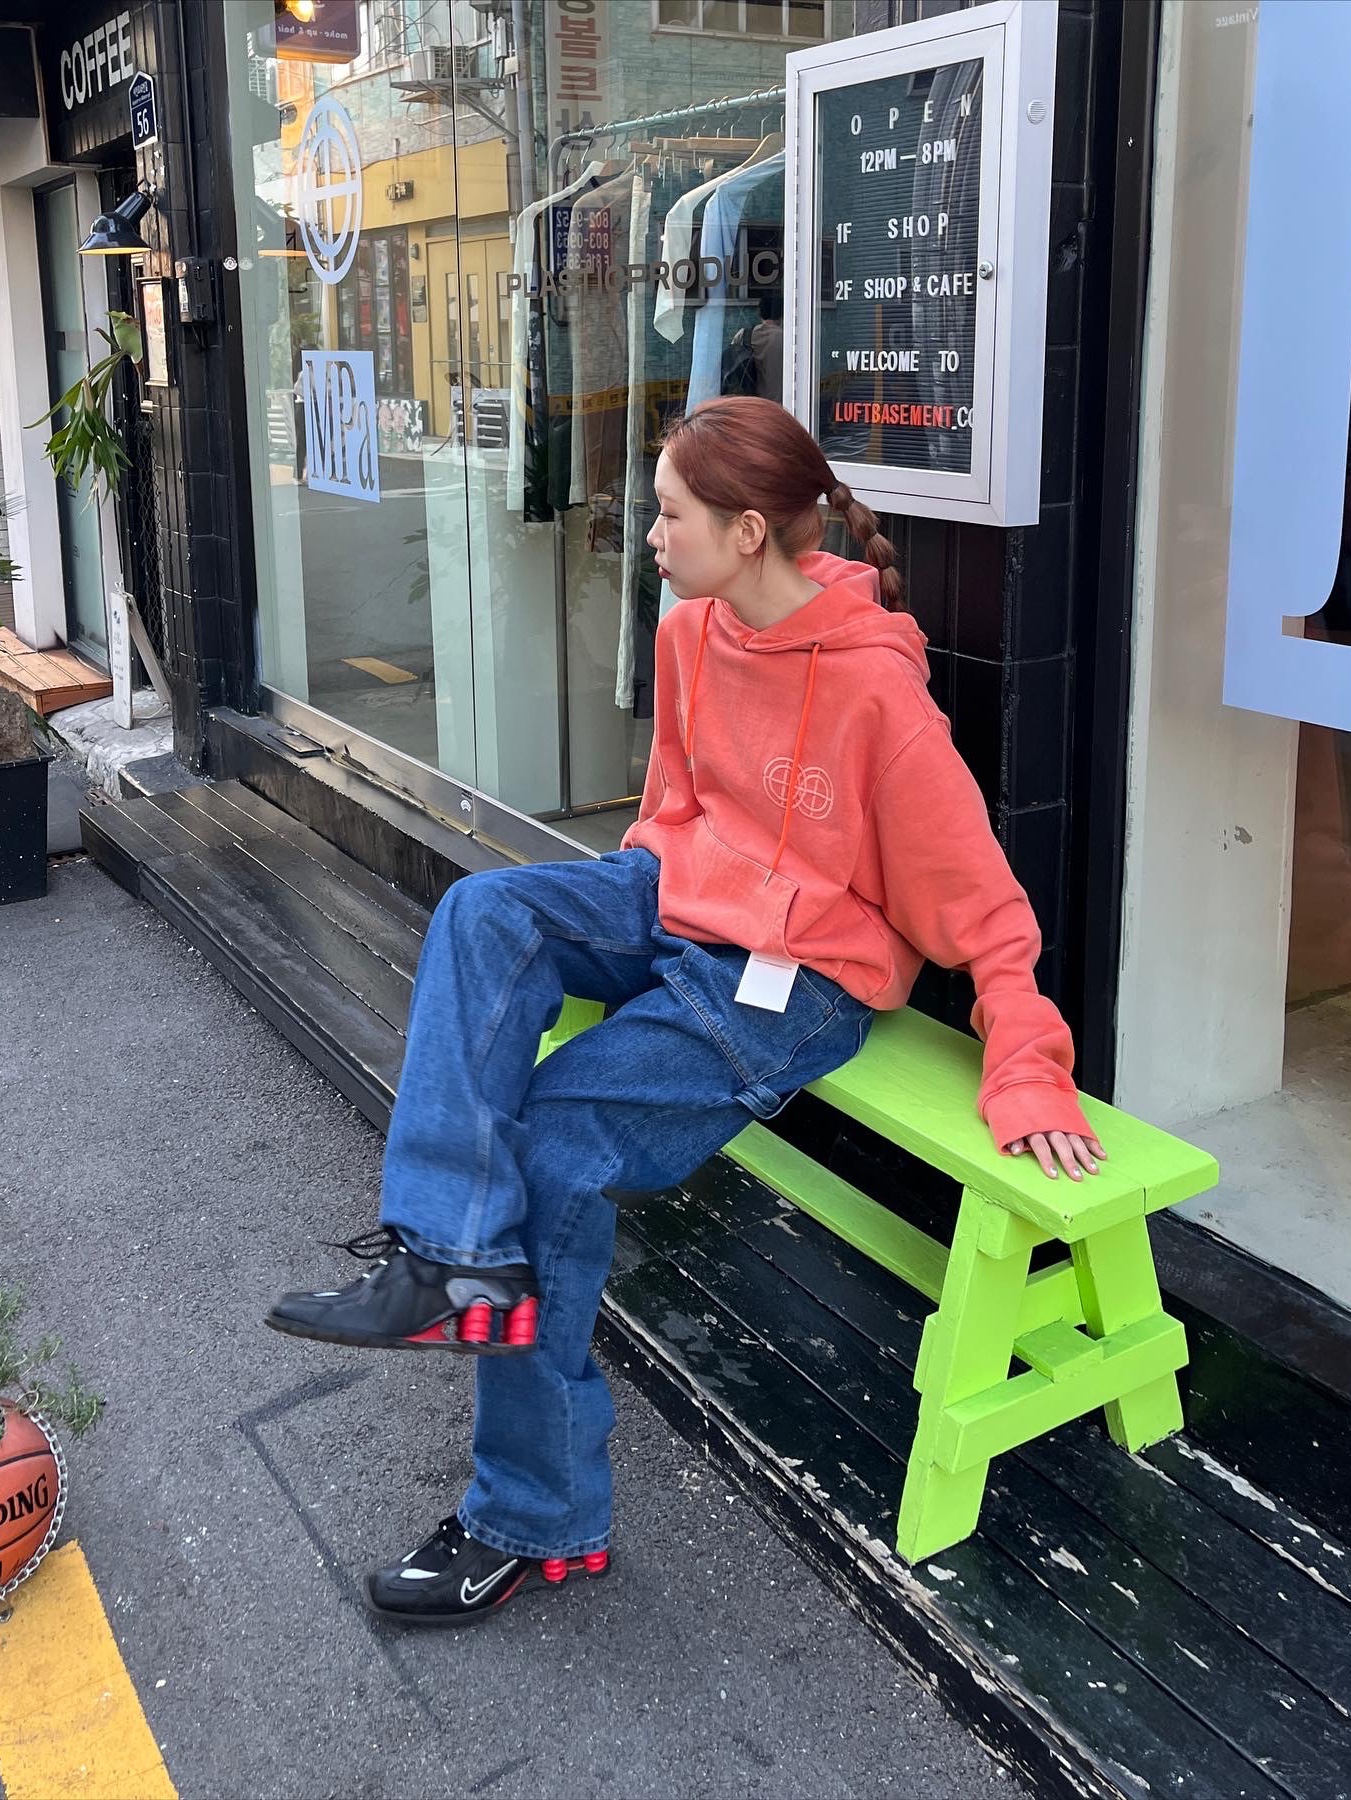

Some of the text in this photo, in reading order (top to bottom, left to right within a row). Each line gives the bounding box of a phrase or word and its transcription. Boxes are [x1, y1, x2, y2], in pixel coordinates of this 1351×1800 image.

[60, 10, 134, 111] COFFEE
[136, 107, 149, 138] 56
[836, 212, 949, 244] 1F SHOP
[507, 251, 784, 300] PLASTICPRODUC
[835, 272, 974, 301] 2F SHOP & CAFE
[846, 350, 920, 372] WELCOME
[938, 350, 960, 373] TO
[305, 360, 376, 492] MPa
